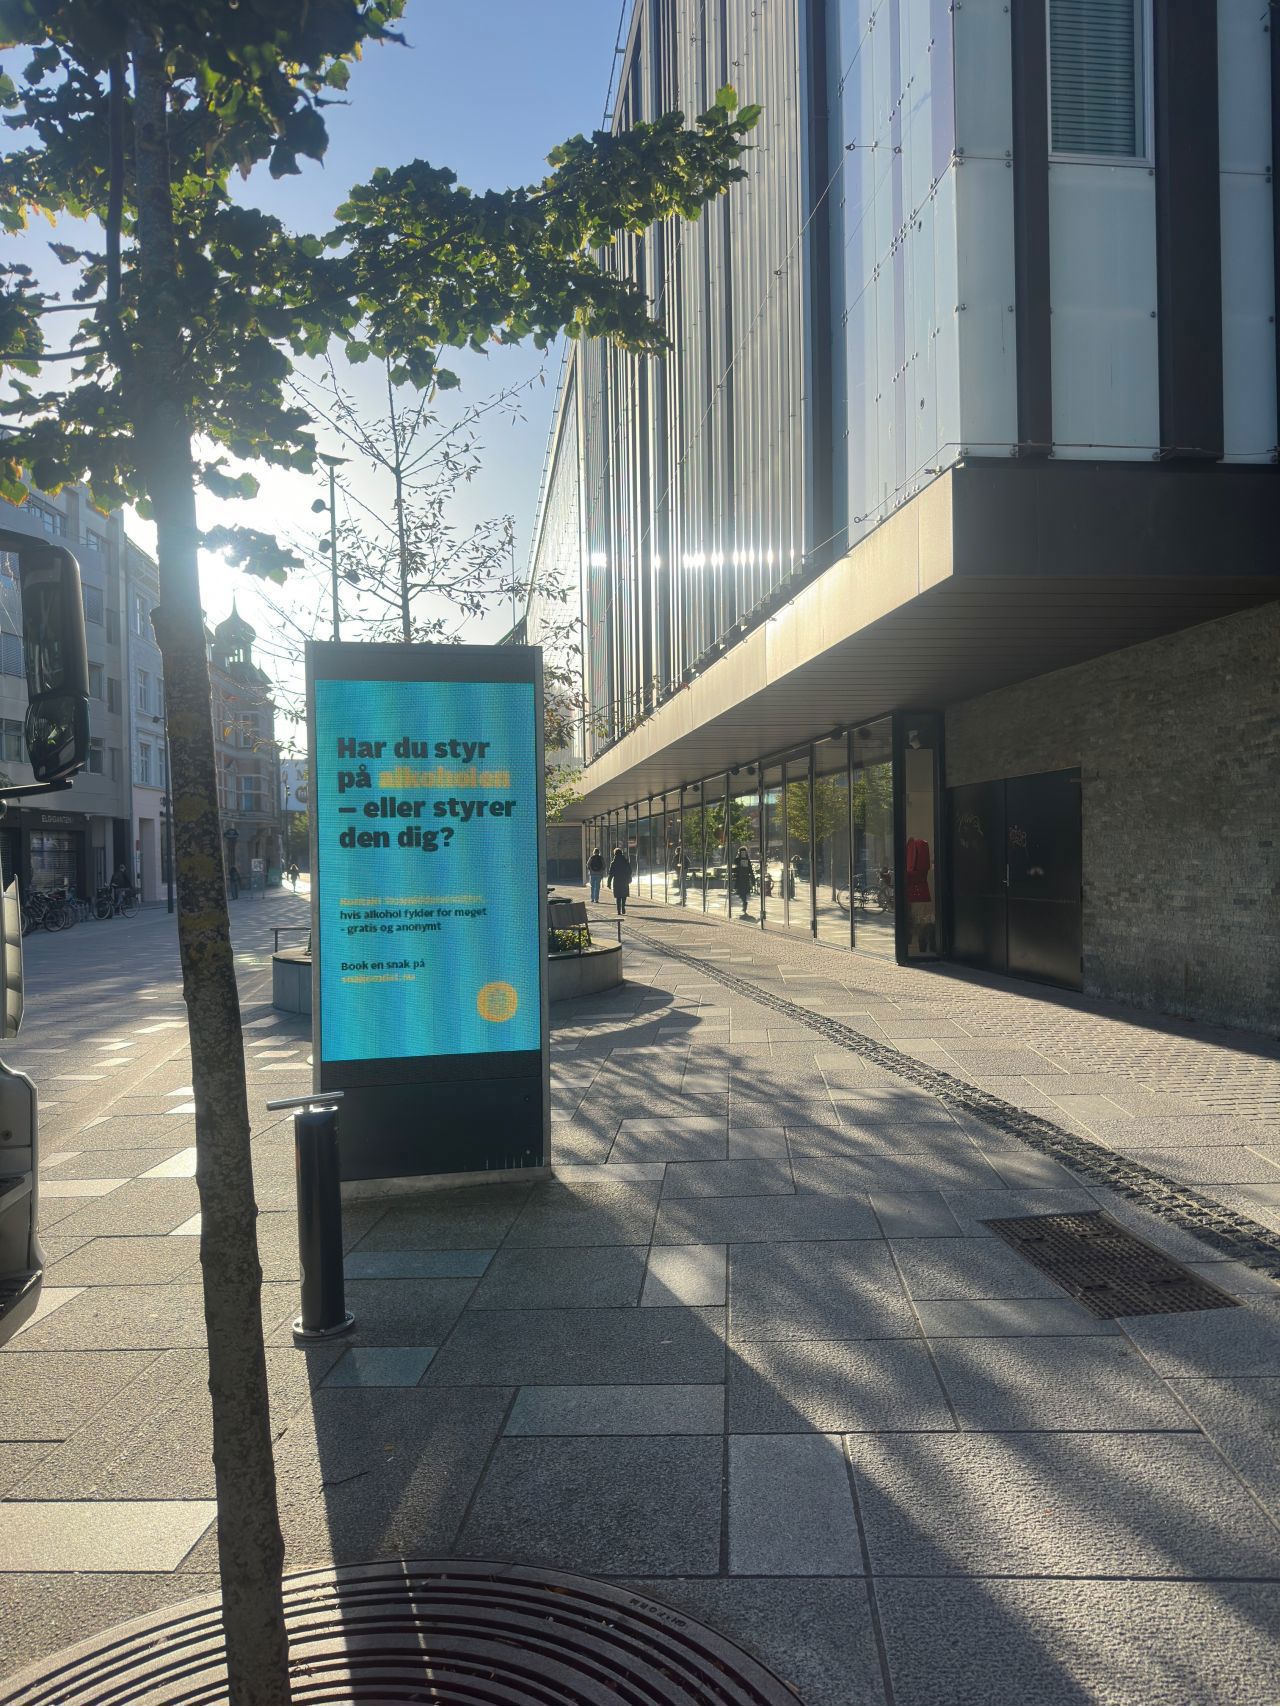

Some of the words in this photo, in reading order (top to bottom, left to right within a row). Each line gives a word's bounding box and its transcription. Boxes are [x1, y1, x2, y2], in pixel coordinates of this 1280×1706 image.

[337, 737, 387, 759] Har
[394, 736, 429, 759] du
[434, 738, 491, 763] styr
[337, 764, 372, 794] på
[363, 797, 426, 818] eller
[433, 798, 517, 823] styrer
[339, 826, 390, 848] den
[397, 826, 455, 852] dig?
[340, 910, 361, 920] hvis
[364, 909, 401, 919] alkohol
[404, 908, 434, 920] fylder
[437, 908, 452, 917] for
[454, 907, 488, 918] meget
[347, 924, 378, 935] gratis
[380, 924, 394, 934] og
[396, 922, 442, 933] anonymt
[341, 961, 369, 971] Book
[371, 962, 384, 970] en
[386, 960, 410, 970] snak
[413, 958, 425, 970] på
